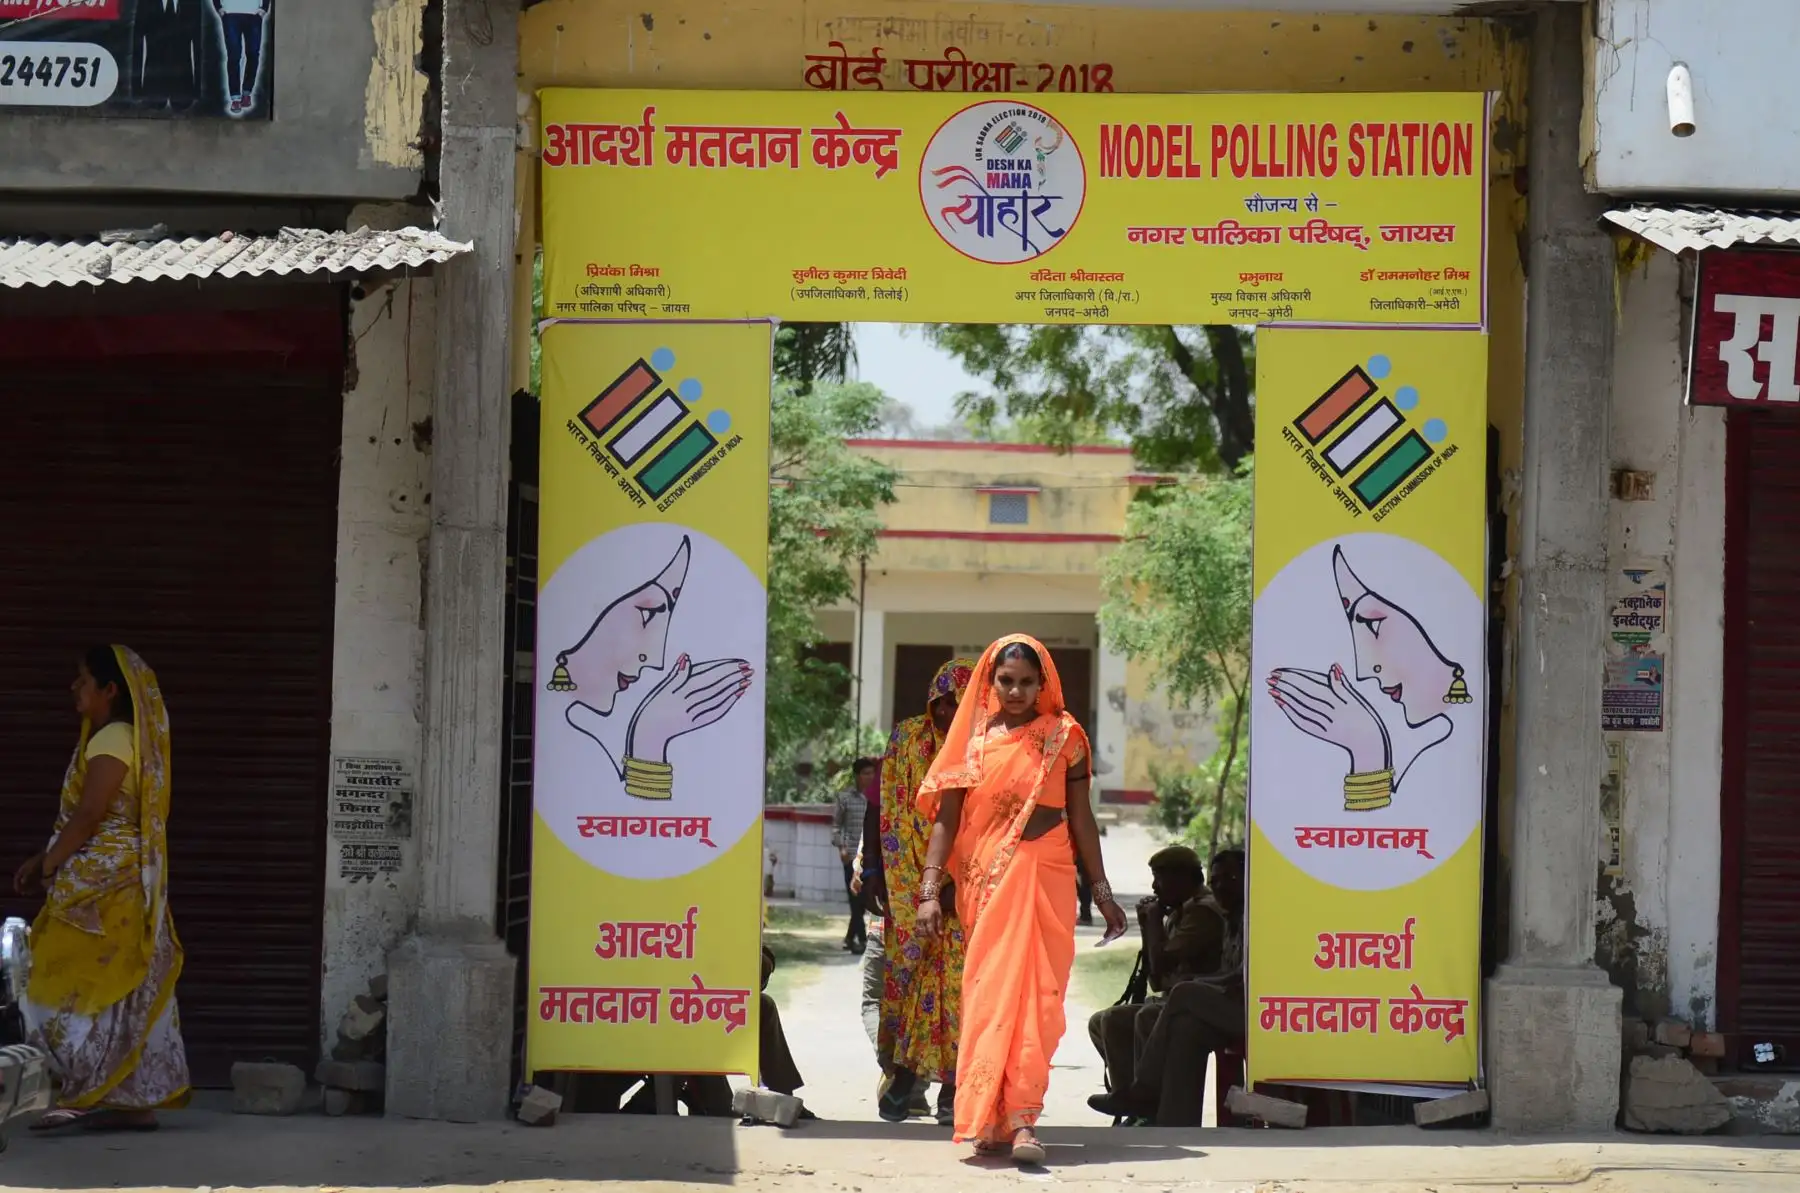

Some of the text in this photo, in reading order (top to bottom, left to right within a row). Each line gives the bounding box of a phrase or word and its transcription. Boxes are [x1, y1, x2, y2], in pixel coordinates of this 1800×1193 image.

[1, 55, 101, 88] 244751
[992, 108, 1026, 124] ELECTION
[1027, 110, 1047, 124] 2019
[542, 107, 903, 179] आदर्श मतदान केन्द्र
[1100, 123, 1473, 178] MODEL POLLING STATION
[986, 159, 1032, 171] DESH KA
[986, 173, 1032, 189] MAHA
[1244, 193, 1297, 213] सौजन्य
[1305, 193, 1318, 213] से
[1128, 225, 1186, 245] नगर
[1192, 219, 1281, 245] पालिका
[1379, 224, 1456, 243] जायस
[586, 264, 660, 278] प्रियंका मिश्रा
[792, 266, 907, 284] सुनील कुमार त्रिवेदी
[1070, 268, 1125, 282] श्रीवास्तव
[1377, 268, 1441, 281] राममनोहर
[1443, 267, 1470, 280] मिश्र
[556, 302, 576, 312] नगर
[580, 300, 613, 312] पालिका
[662, 303, 690, 313] जायस
[1015, 291, 1036, 301] अपर
[1039, 288, 1095, 301] जिलाधिकारी
[1210, 288, 1311, 306] मुख्य विकास अधिकारी
[1714, 294, 1800, 402] स
[566, 419, 647, 508] भारत निर्वाचन आयोग
[656, 434, 743, 513] ELECTION COMMISSION OF INDIA
[1281, 426, 1363, 518] भारत निर्वाचन आयोग
[1372, 444, 1459, 522] ELECTION COMMISSION OF INDIA
[576, 816, 717, 848] स्वागतम्
[1294, 827, 1435, 859] स्वागतम्
[595, 906, 698, 959] आदर्श
[1314, 917, 1416, 969] आदर्श
[539, 973, 751, 1033] मतदान केन्द्र
[1259, 983, 1468, 1043] मतदान केन्द्र
